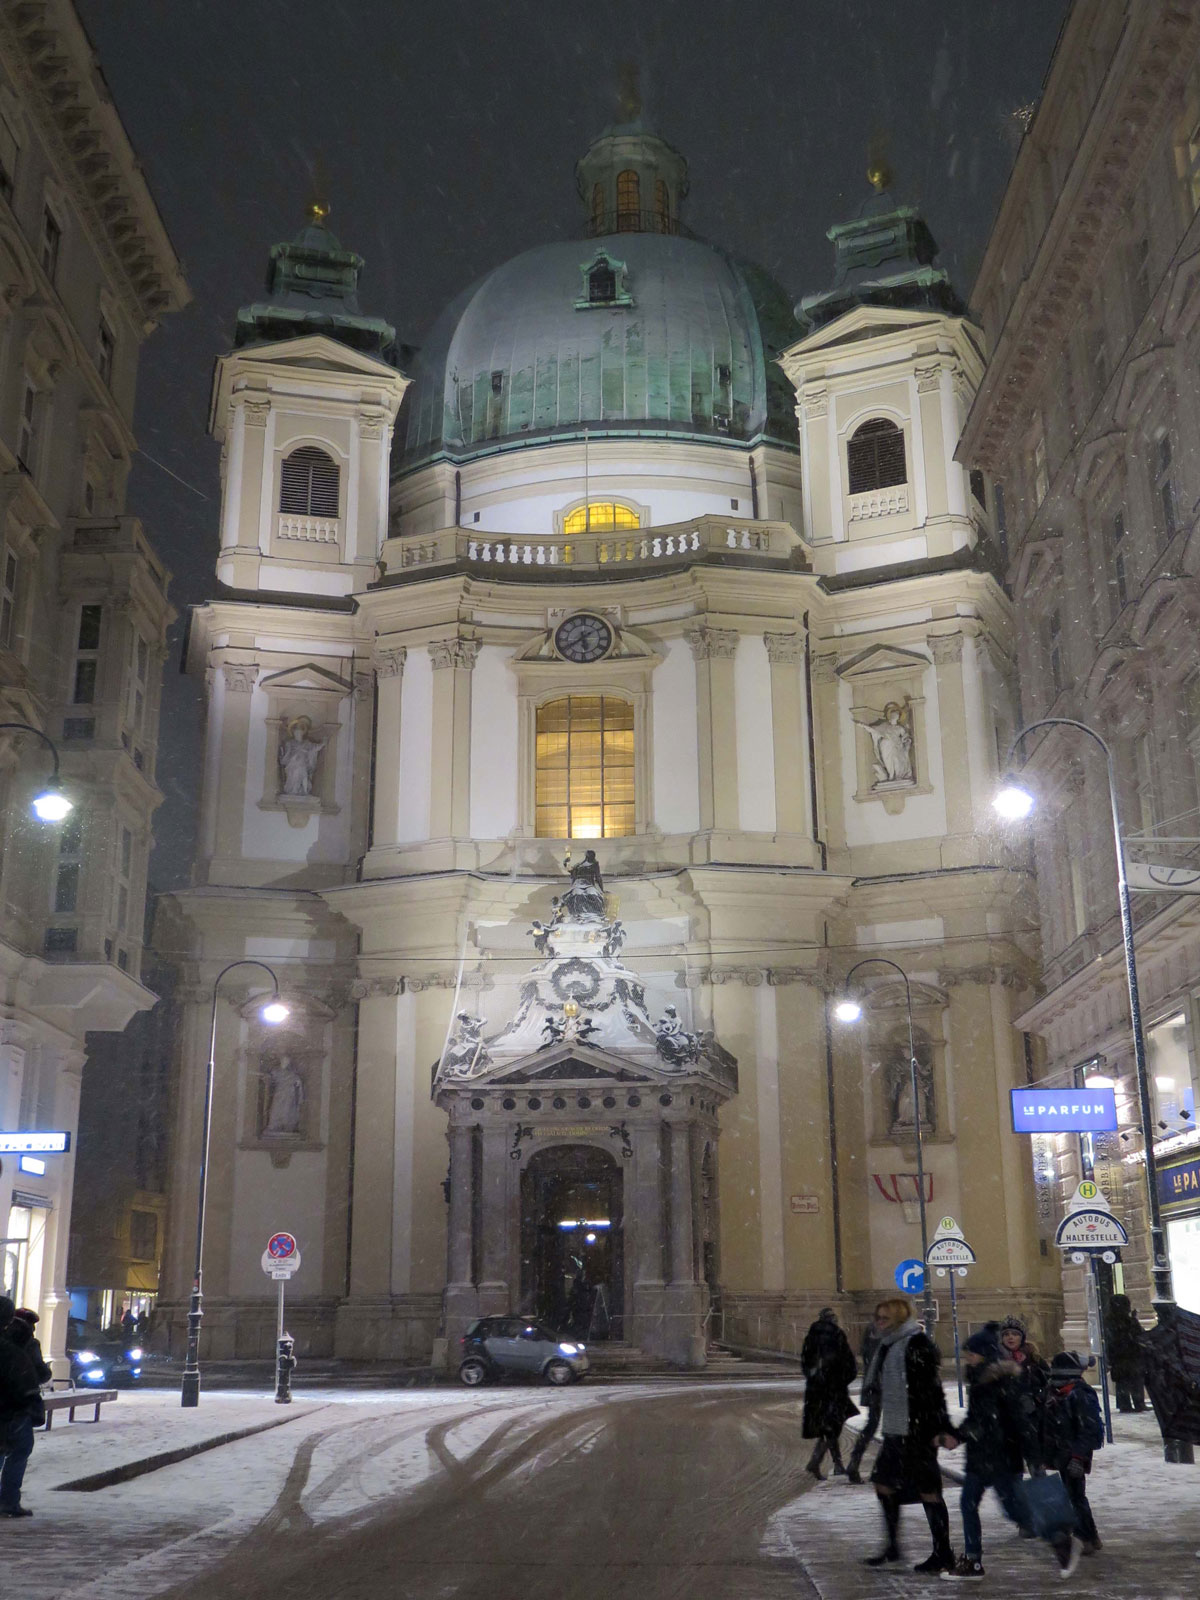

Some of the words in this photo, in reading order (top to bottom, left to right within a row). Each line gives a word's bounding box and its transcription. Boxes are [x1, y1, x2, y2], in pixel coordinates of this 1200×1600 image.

[1023, 1106, 1035, 1115] LE
[1038, 1104, 1105, 1115] PARFUM
[1173, 1174, 1182, 1193] LE
[1183, 1168, 1200, 1190] PA
[1082, 1184, 1094, 1196] H
[1072, 1215, 1111, 1228] AUTOBUS
[1066, 1233, 1118, 1242] HALTESTELLE
[936, 1241, 964, 1250] AUTOBUS
